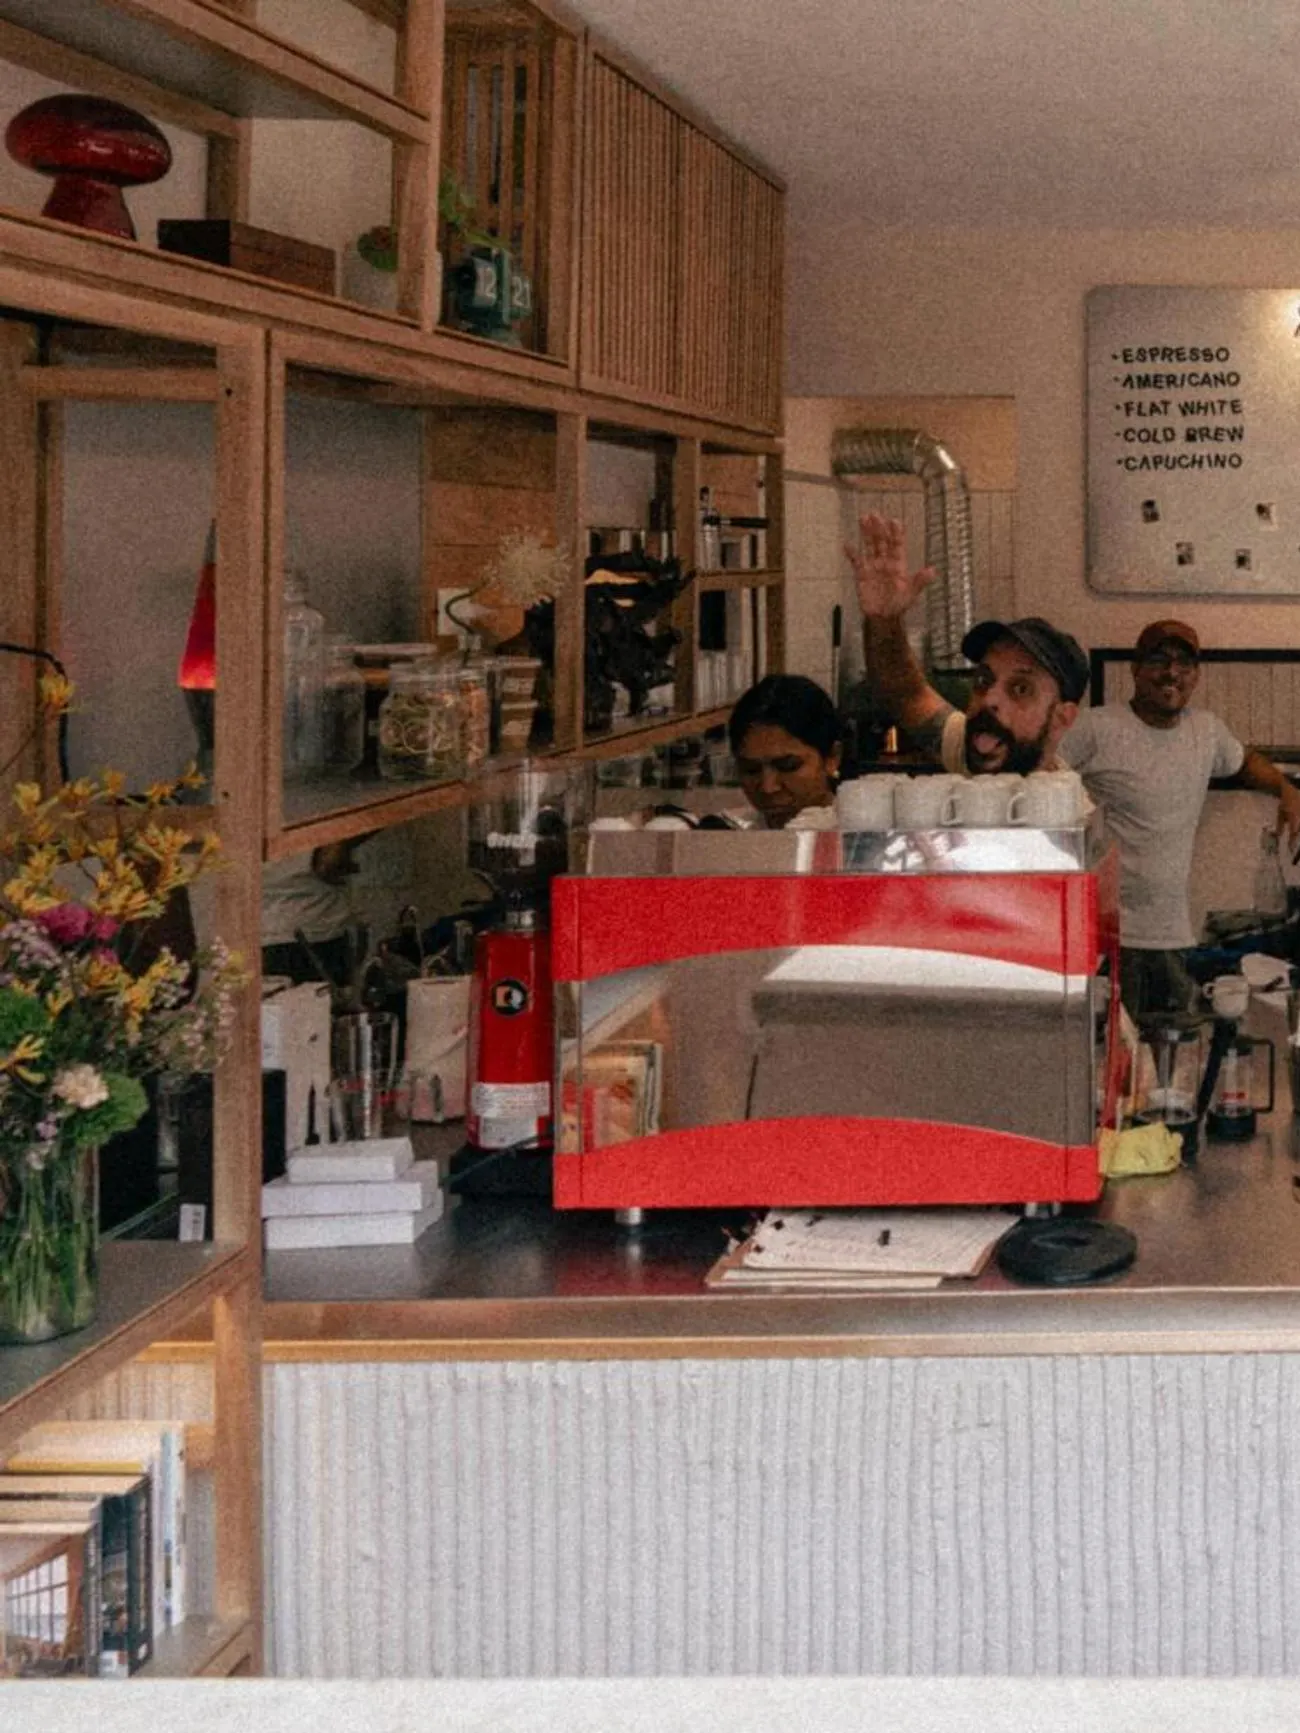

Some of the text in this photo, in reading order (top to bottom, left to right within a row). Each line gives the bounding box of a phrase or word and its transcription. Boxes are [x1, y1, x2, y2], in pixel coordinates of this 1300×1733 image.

[1122, 347, 1230, 363] ESPRESSO
[1122, 371, 1241, 389] AMERICANO
[1124, 399, 1242, 417] FLAT WHITE
[1123, 425, 1244, 444] COLD BREW
[1124, 453, 1242, 471] CAPUCHINO
